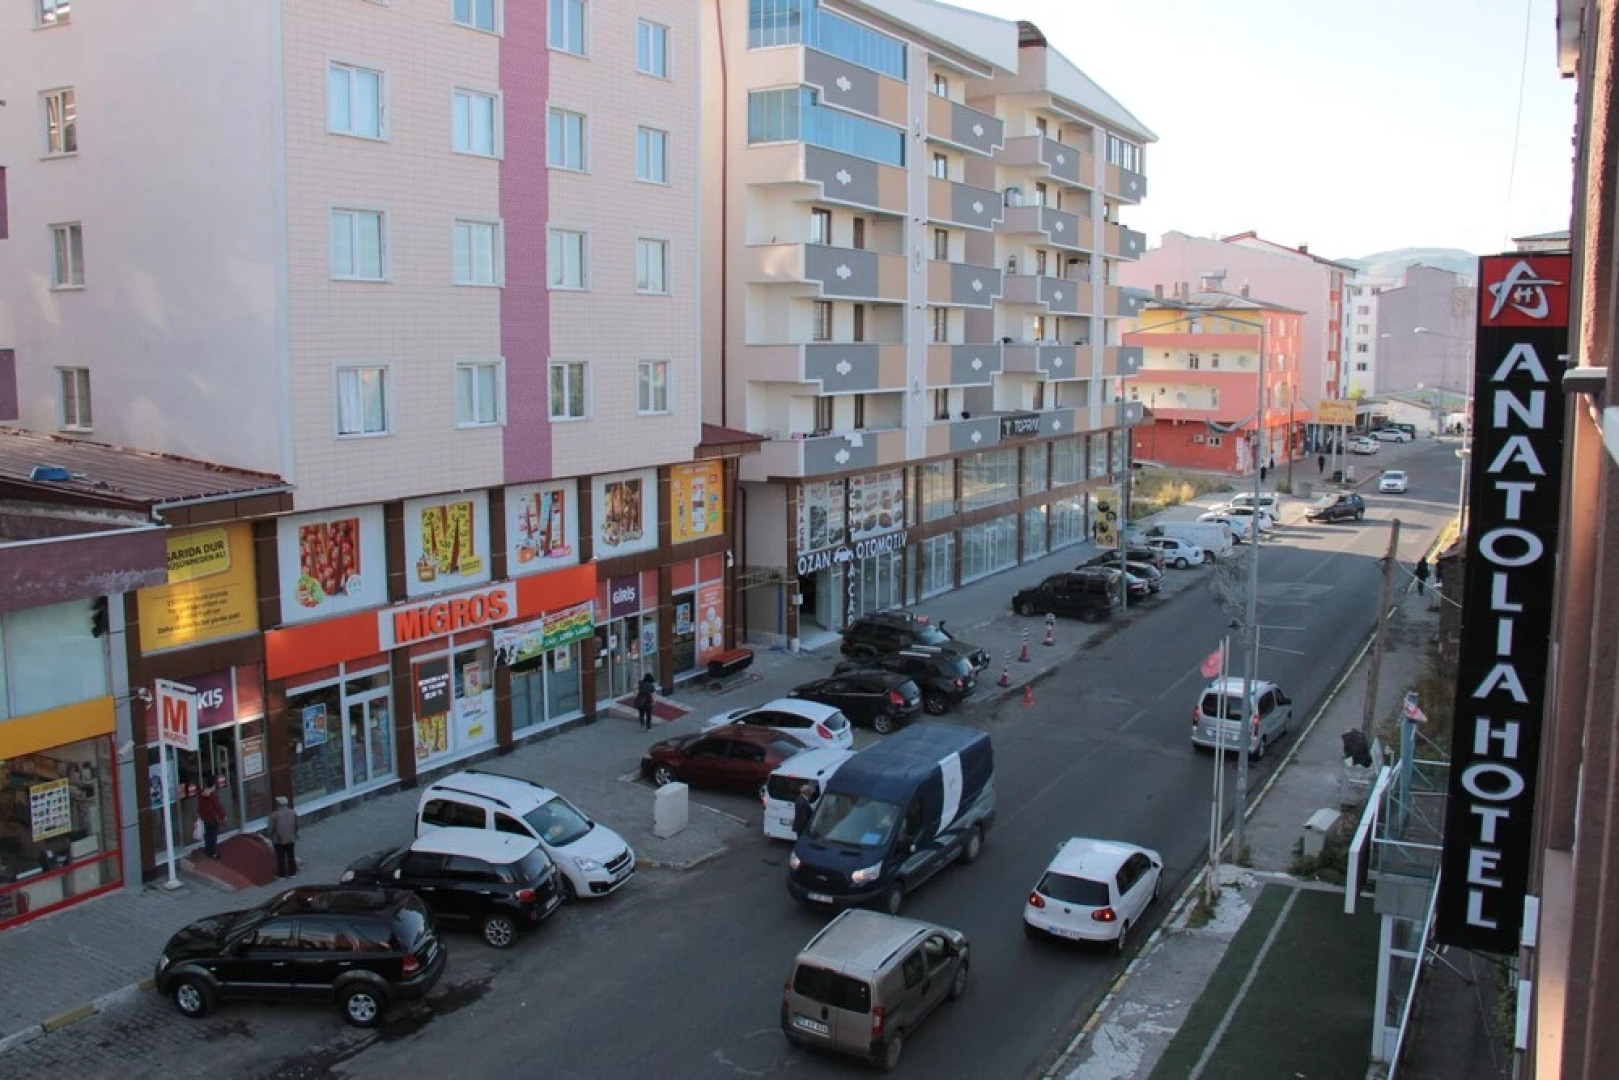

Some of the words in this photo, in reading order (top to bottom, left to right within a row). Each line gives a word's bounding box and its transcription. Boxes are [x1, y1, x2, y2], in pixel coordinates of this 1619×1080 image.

[1472, 342, 1550, 703] ANATOLIA
[798, 549, 831, 576] OZAN
[163, 695, 188, 736] M
[197, 688, 223, 710] KIŞ
[1461, 716, 1525, 929] HOTEL
